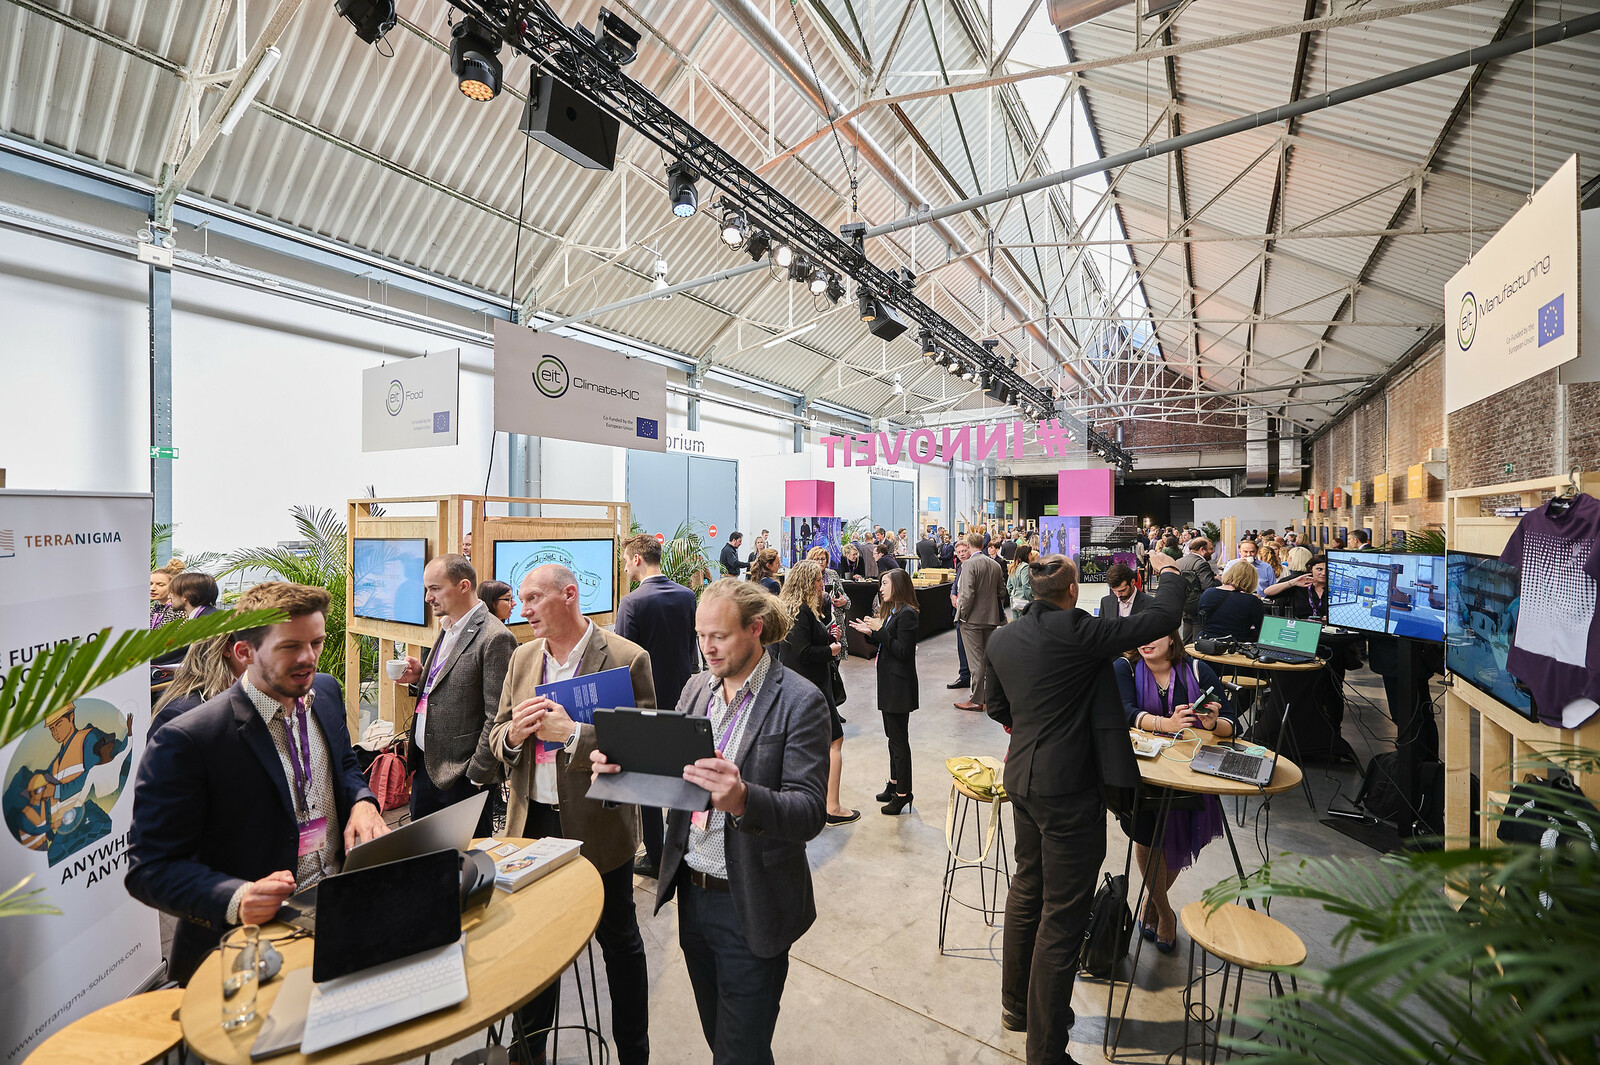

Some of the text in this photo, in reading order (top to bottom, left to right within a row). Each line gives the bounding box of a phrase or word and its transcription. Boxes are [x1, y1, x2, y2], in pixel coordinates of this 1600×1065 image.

[1479, 255, 1550, 318] Manufacturing
[406, 389, 424, 400] Food
[541, 369, 640, 401] eit Climate-KIC
[606, 422, 622, 430] European
[24, 532, 121, 548] TERRANIGMA
[7, 942, 142, 1060] www.terranigma-solutions.com
